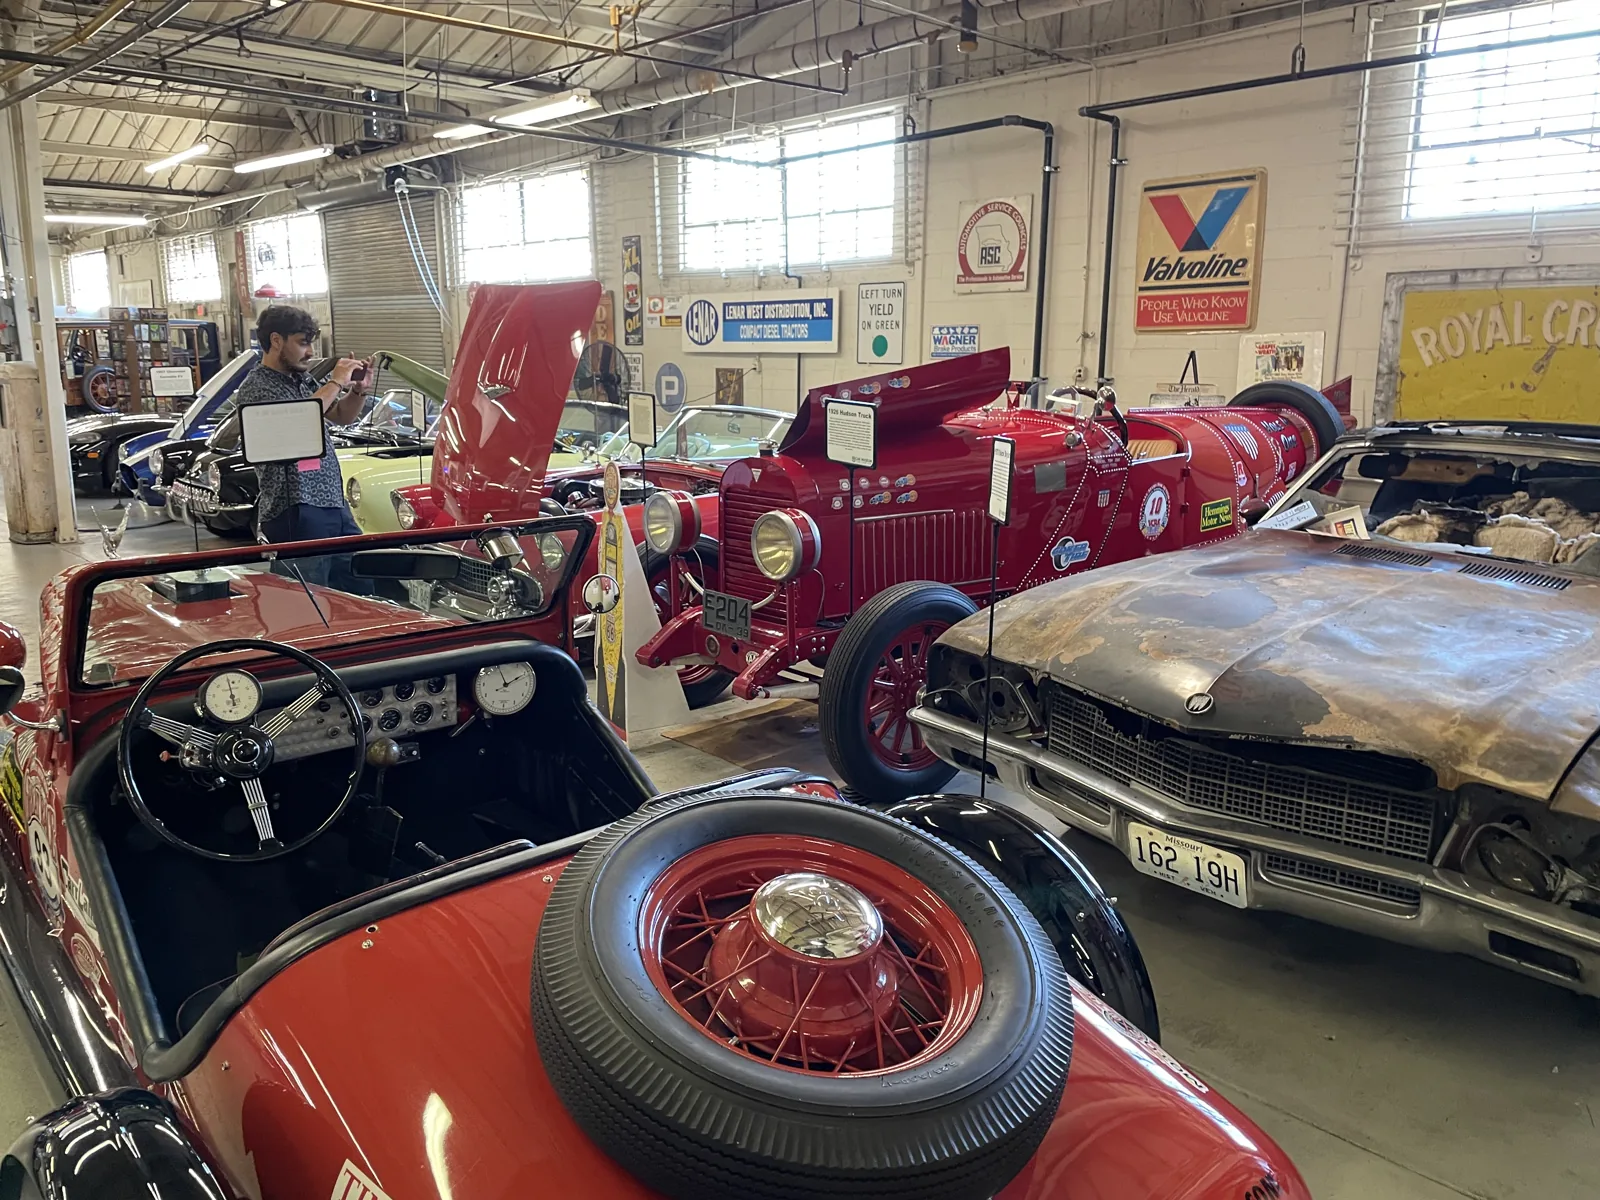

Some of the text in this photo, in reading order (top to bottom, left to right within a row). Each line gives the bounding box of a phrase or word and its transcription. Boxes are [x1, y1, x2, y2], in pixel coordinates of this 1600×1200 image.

[960, 203, 1026, 254] AUTOMOTIVE SERVICE COUNCILS
[623, 246, 640, 271] XL
[980, 246, 1001, 265] ASC
[1143, 254, 1248, 281] Valvoline
[861, 288, 902, 299] LEFT TURN
[725, 302, 828, 320] LENAR WEST DISTRIBUTION, INC.
[869, 303, 893, 316] YIELD
[1140, 296, 1246, 311] PEOPLE WHO KNOW
[626, 313, 641, 332] OIL
[687, 301, 717, 343] LENAR
[861, 320, 900, 330] ON GREEN
[1153, 310, 1229, 323] USE VALVOLINE
[740, 323, 808, 339] COMPACT DIESEL TRACTORS
[933, 335, 976, 345] WAGNER
[1411, 299, 1600, 368] ROYAL CR
[661, 375, 679, 404] P
[1179, 384, 1200, 394] Herald
[839, 409, 857, 417] Hudson
[858, 411, 872, 419] Truck
[1149, 496, 1163, 516] 10
[1204, 503, 1230, 517] Hemmings
[1202, 517, 1218, 527] Motor
[1165, 835, 1203, 853] Missouri
[1135, 836, 1239, 896] 162 19H
